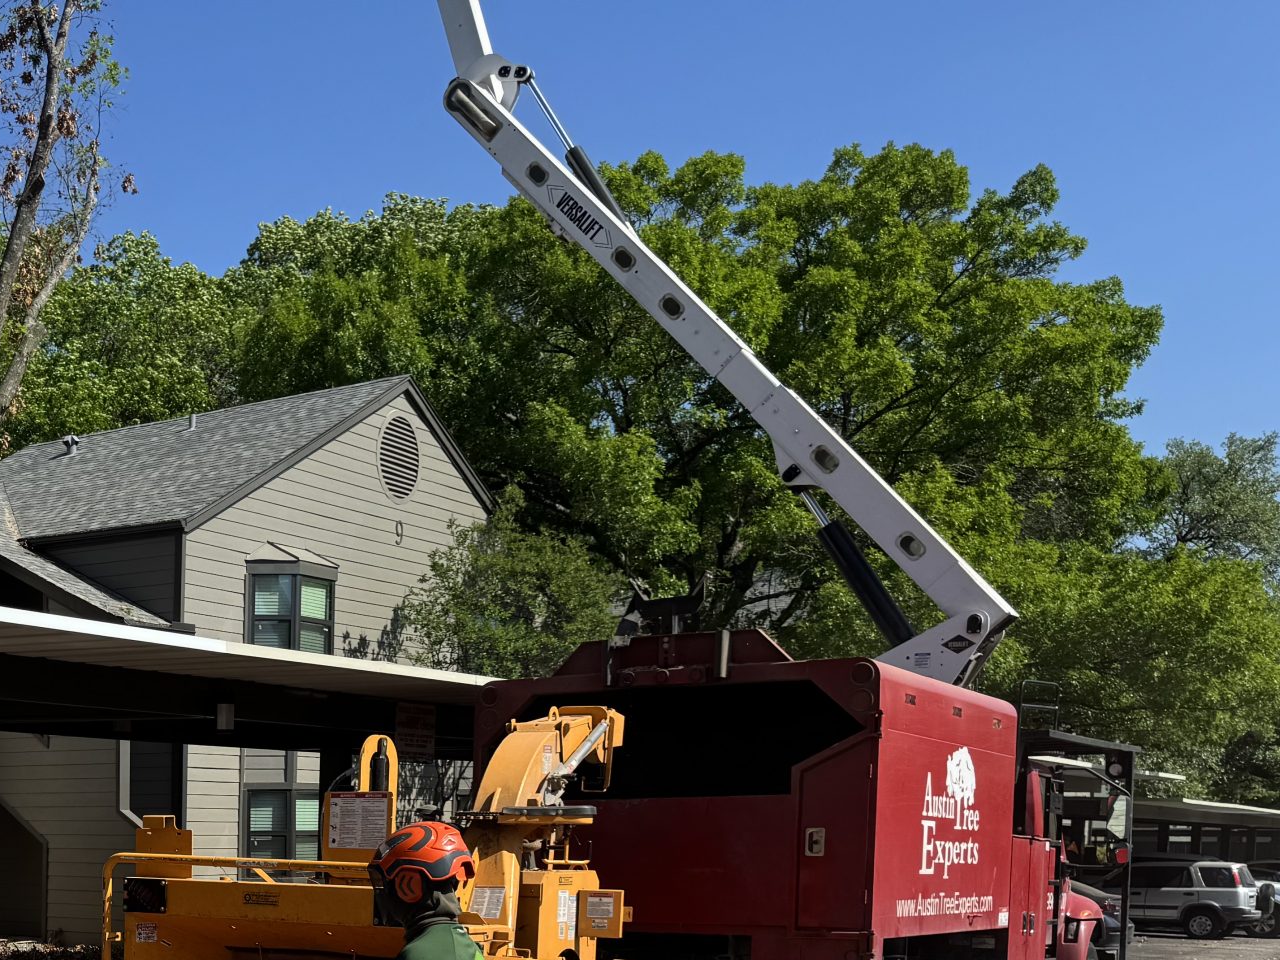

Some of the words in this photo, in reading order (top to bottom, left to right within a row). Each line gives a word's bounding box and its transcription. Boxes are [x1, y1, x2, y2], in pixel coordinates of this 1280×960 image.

[556, 192, 604, 240] VERSALIFT
[395, 520, 403, 545] 9
[922, 772, 955, 819] Austin
[954, 797, 980, 832] Tree
[919, 820, 979, 879] Experts
[896, 891, 993, 918] www.AustinTreeExperts.com
